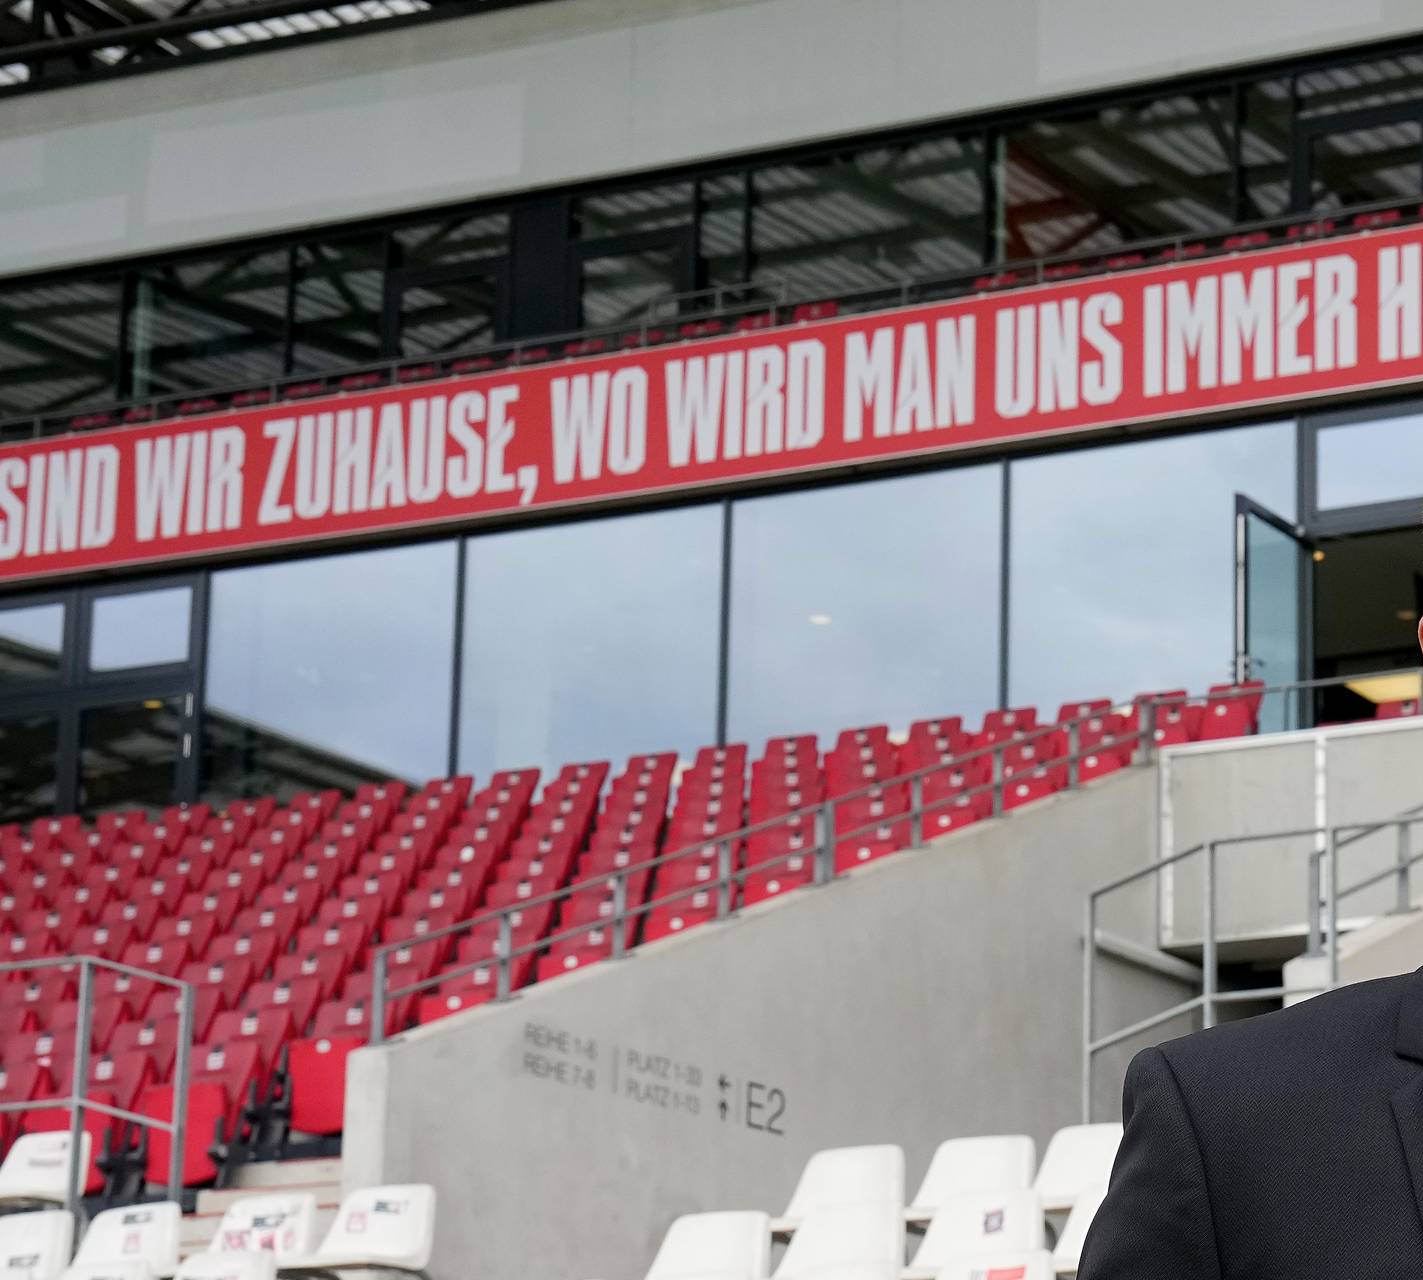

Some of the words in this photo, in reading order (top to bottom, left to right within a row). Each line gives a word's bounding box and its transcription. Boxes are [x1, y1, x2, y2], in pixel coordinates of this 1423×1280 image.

[0, 445, 119, 560] SIND
[136, 427, 245, 541] WIR
[258, 385, 538, 524] ZUHAUSE,
[551, 367, 648, 483] WO
[665, 339, 825, 467] WIRD
[844, 315, 976, 442] MAN
[995, 293, 1122, 418] UNS
[1143, 255, 1357, 397] IMMER
[746, 1081, 786, 1136] E2
